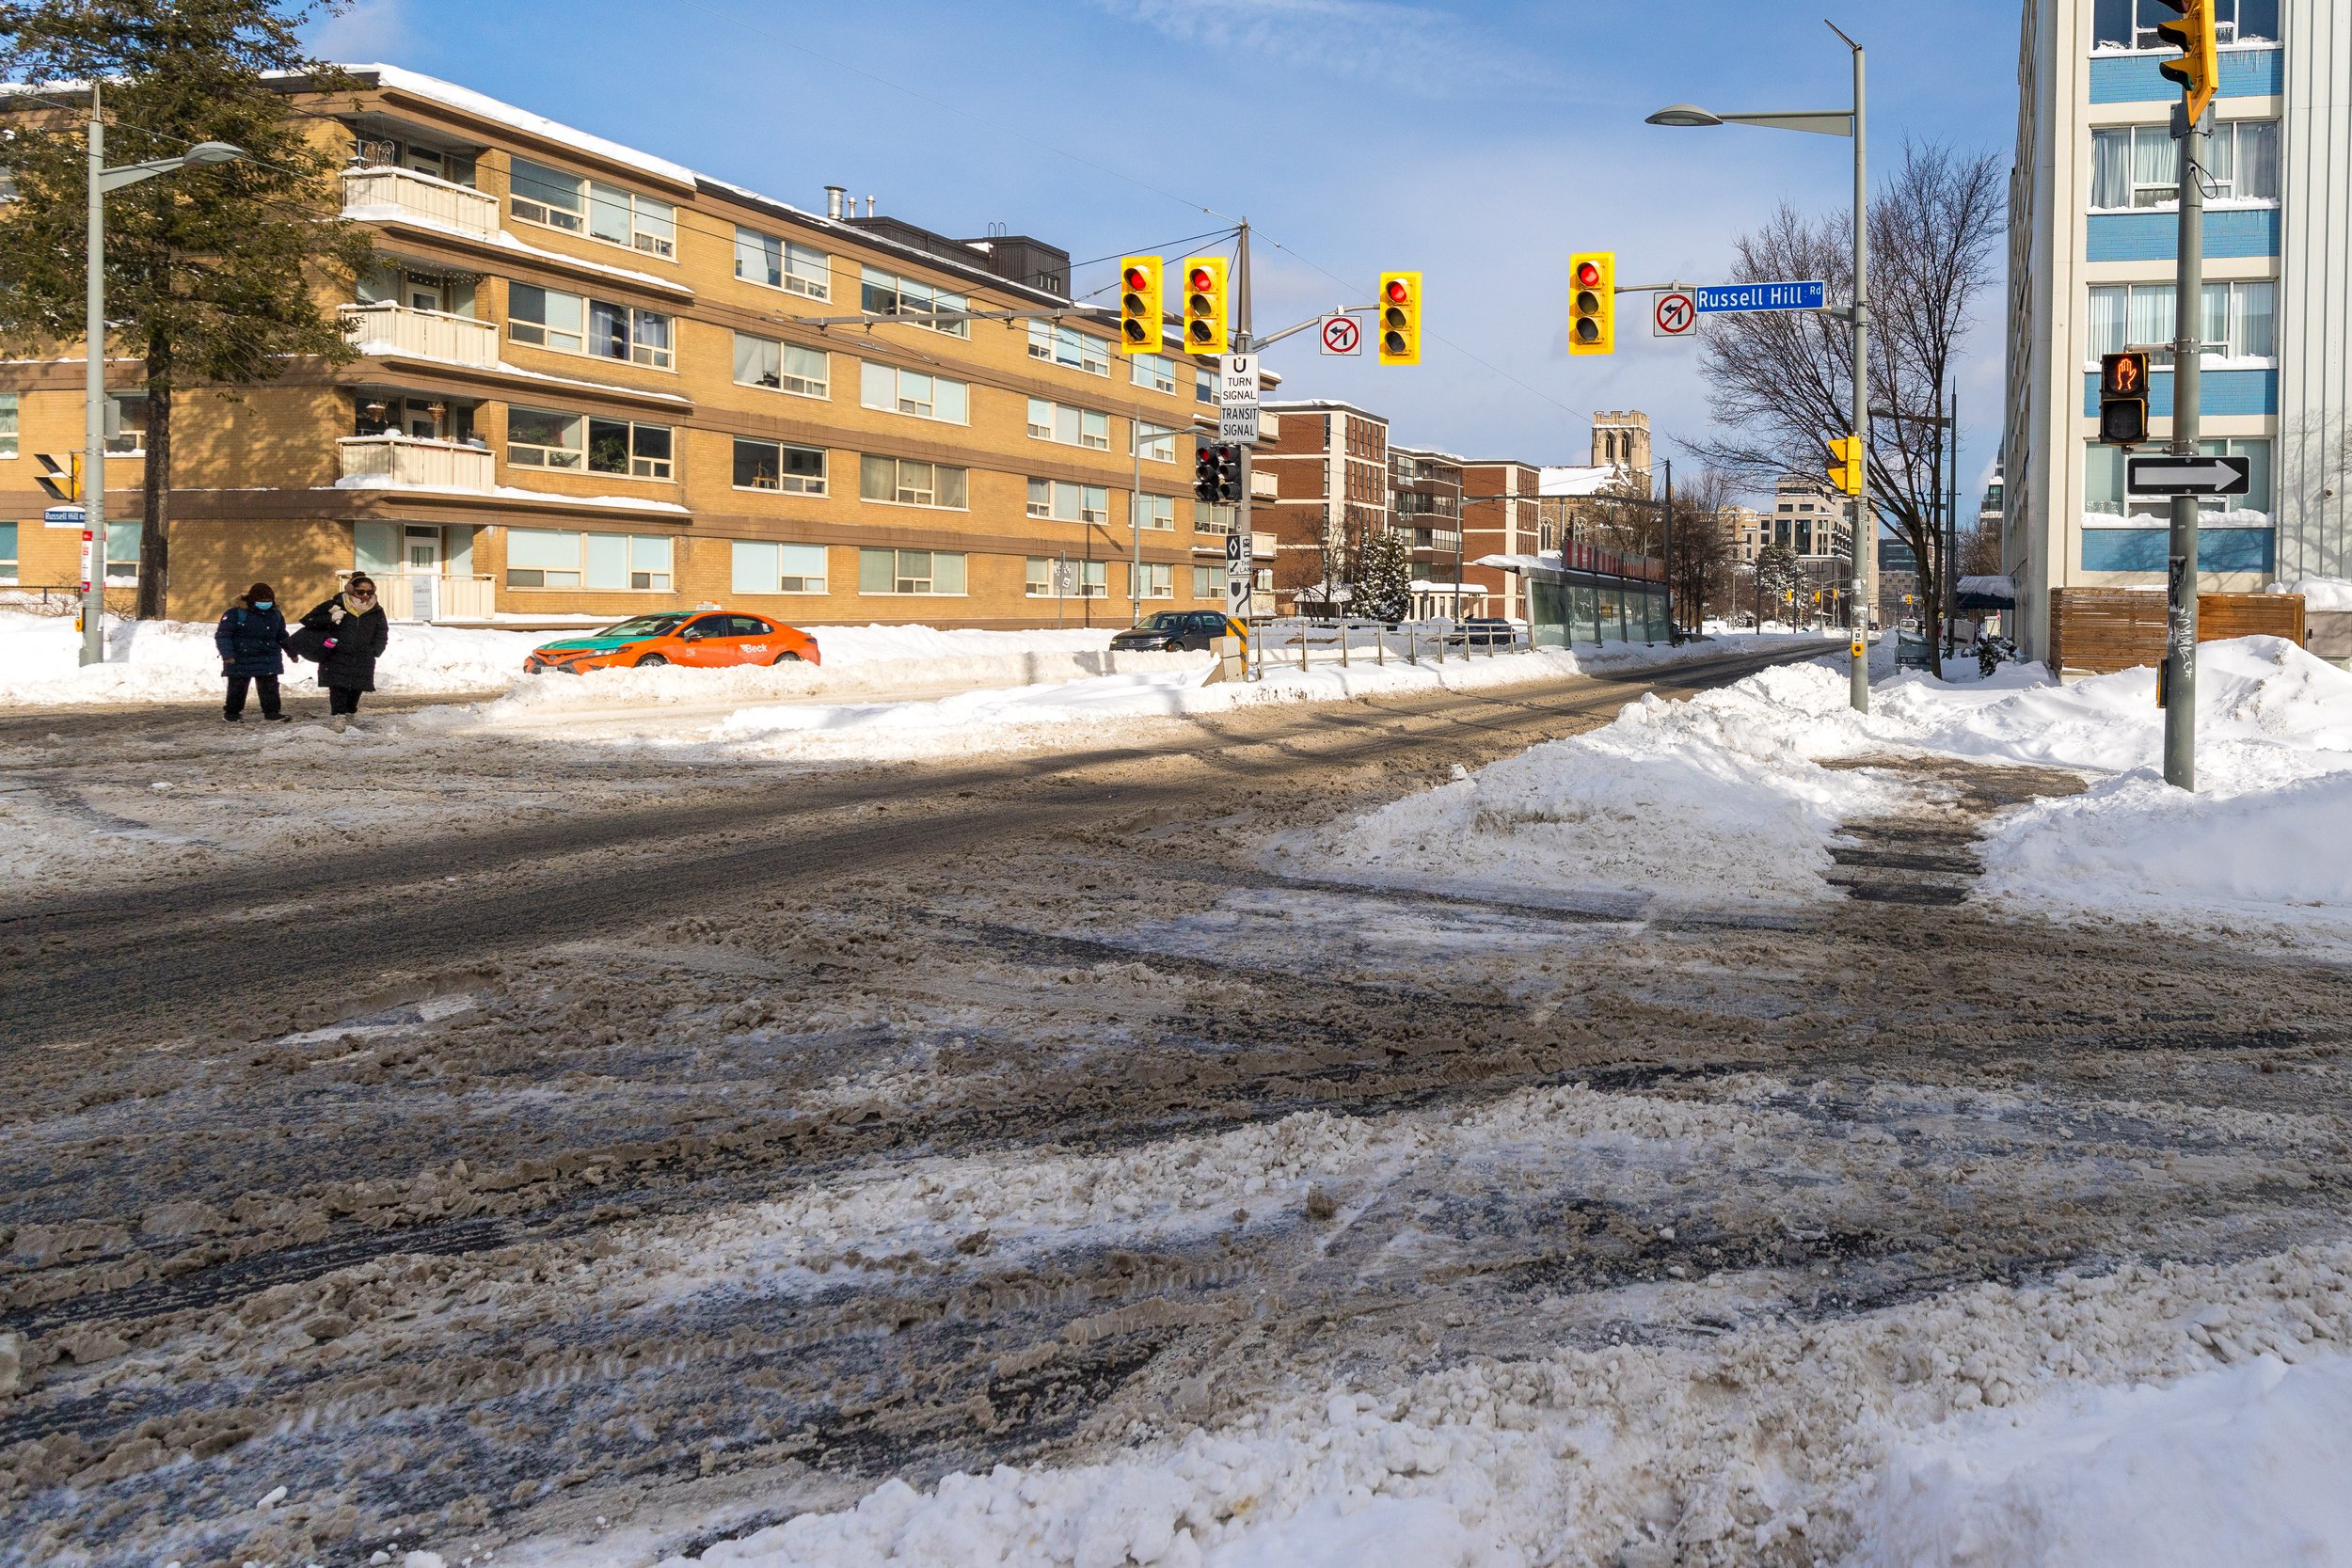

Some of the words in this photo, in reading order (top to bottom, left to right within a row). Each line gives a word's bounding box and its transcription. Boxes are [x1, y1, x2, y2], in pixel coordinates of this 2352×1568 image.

[1698, 288, 1763, 308] Russell
[1771, 286, 1802, 305] Hill
[1809, 285, 1821, 295] Rd
[1233, 358, 1247, 373] U
[1228, 377, 1252, 387] TURN
[1222, 390, 1256, 401] SIGNAL
[1221, 407, 1257, 420] TRANSIT
[1223, 423, 1254, 436] SIGNAL
[45, 512, 67, 520] Russell
[68, 512, 79, 520] Hill
[741, 643, 768, 654] Beck
